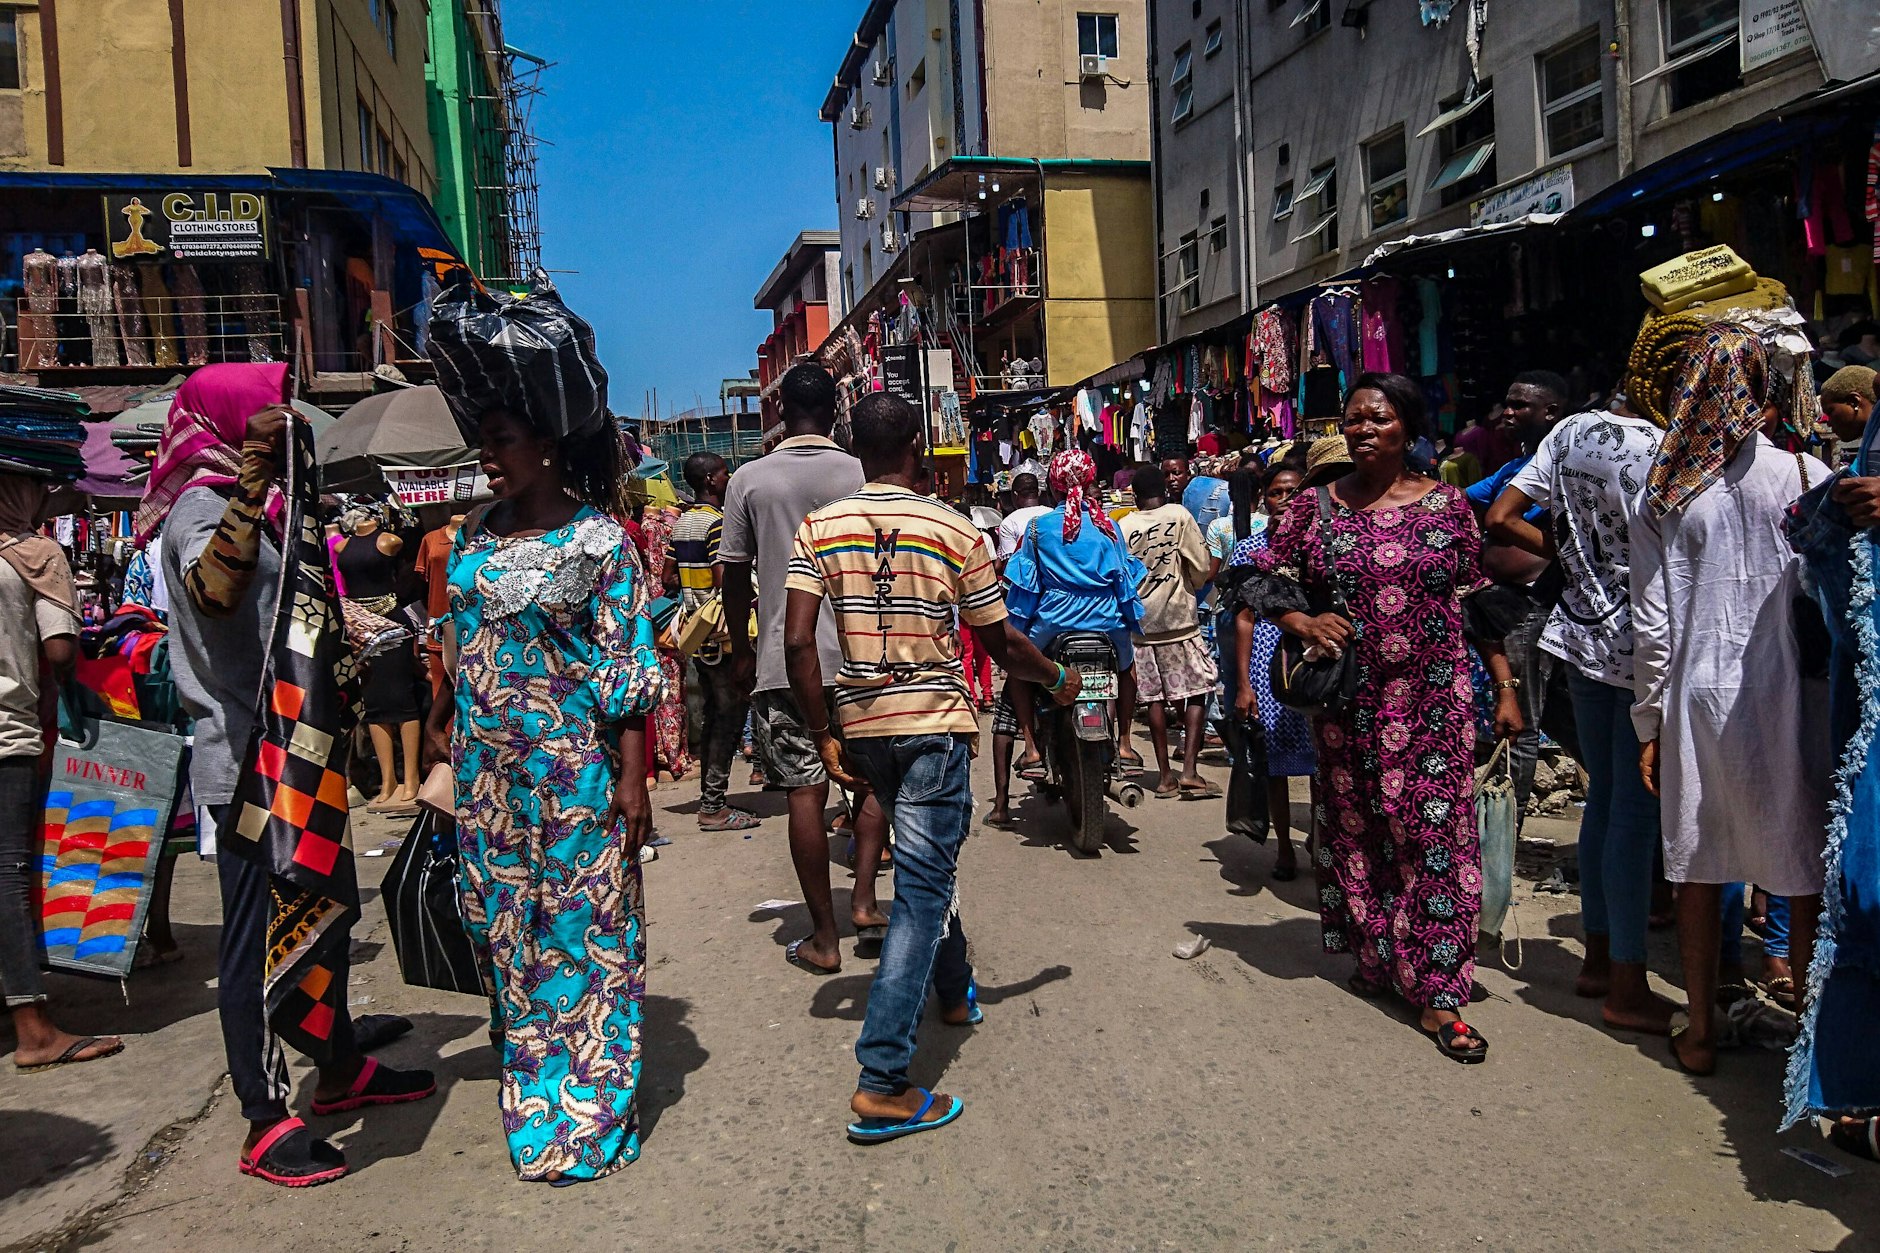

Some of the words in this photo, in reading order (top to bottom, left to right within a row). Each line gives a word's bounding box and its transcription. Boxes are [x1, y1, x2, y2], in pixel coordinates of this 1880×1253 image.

[162, 193, 261, 221] C.I.D
[174, 223, 221, 232] CLOTHING
[222, 222, 256, 232] STORES
[397, 479, 449, 492] AVAILABLE
[400, 489, 449, 503] HERE
[66, 757, 146, 790] WINNER
